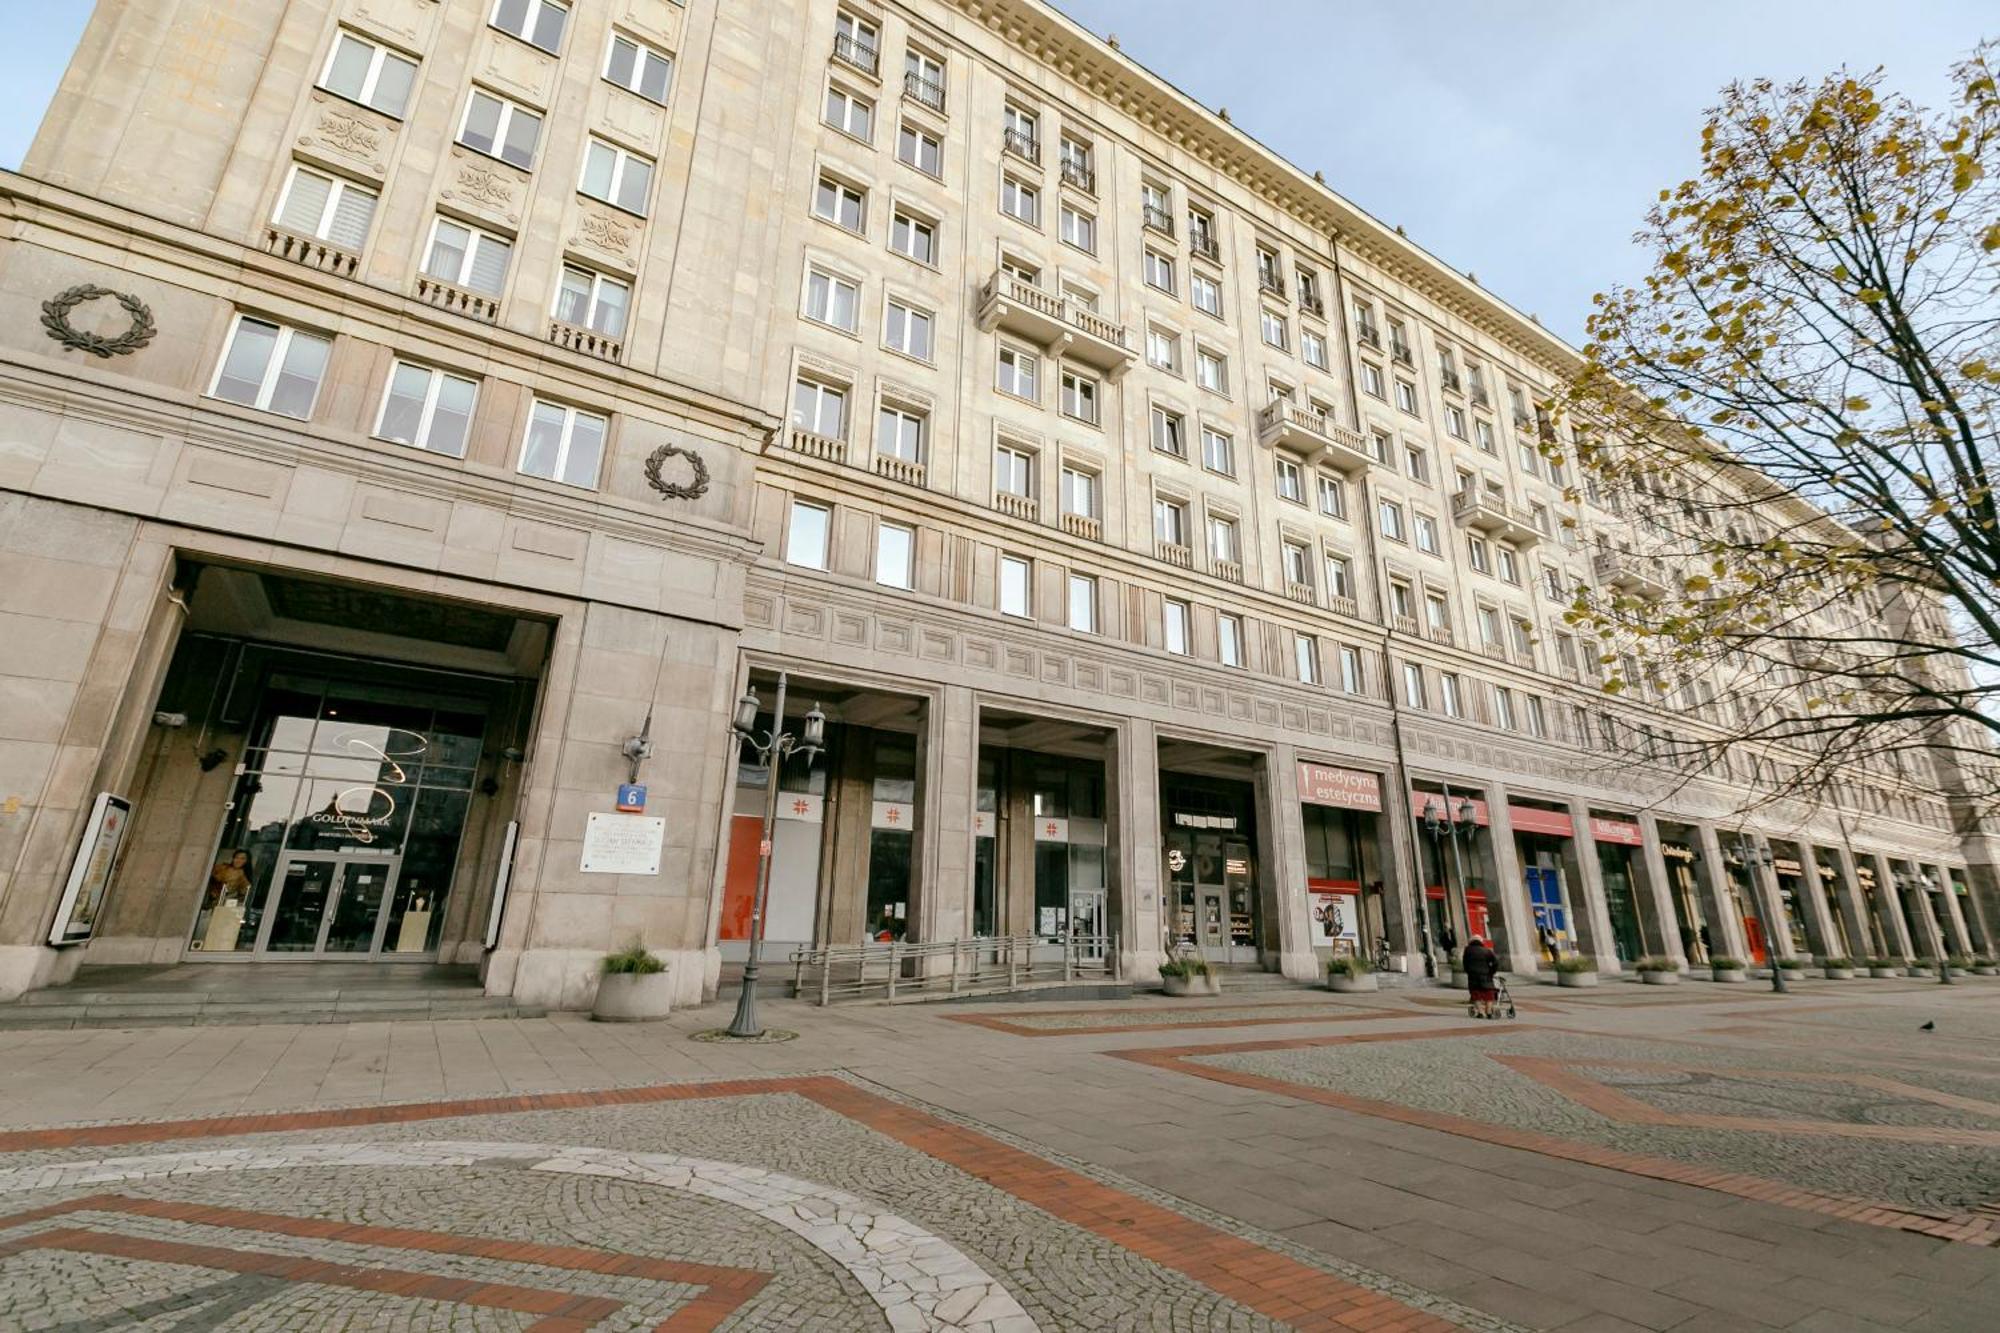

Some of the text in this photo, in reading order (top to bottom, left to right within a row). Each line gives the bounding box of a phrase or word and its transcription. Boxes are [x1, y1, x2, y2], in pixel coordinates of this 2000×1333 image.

[1315, 769, 1377, 790] medycyna
[628, 791, 637, 805] 6
[1316, 787, 1380, 806] estetyczna
